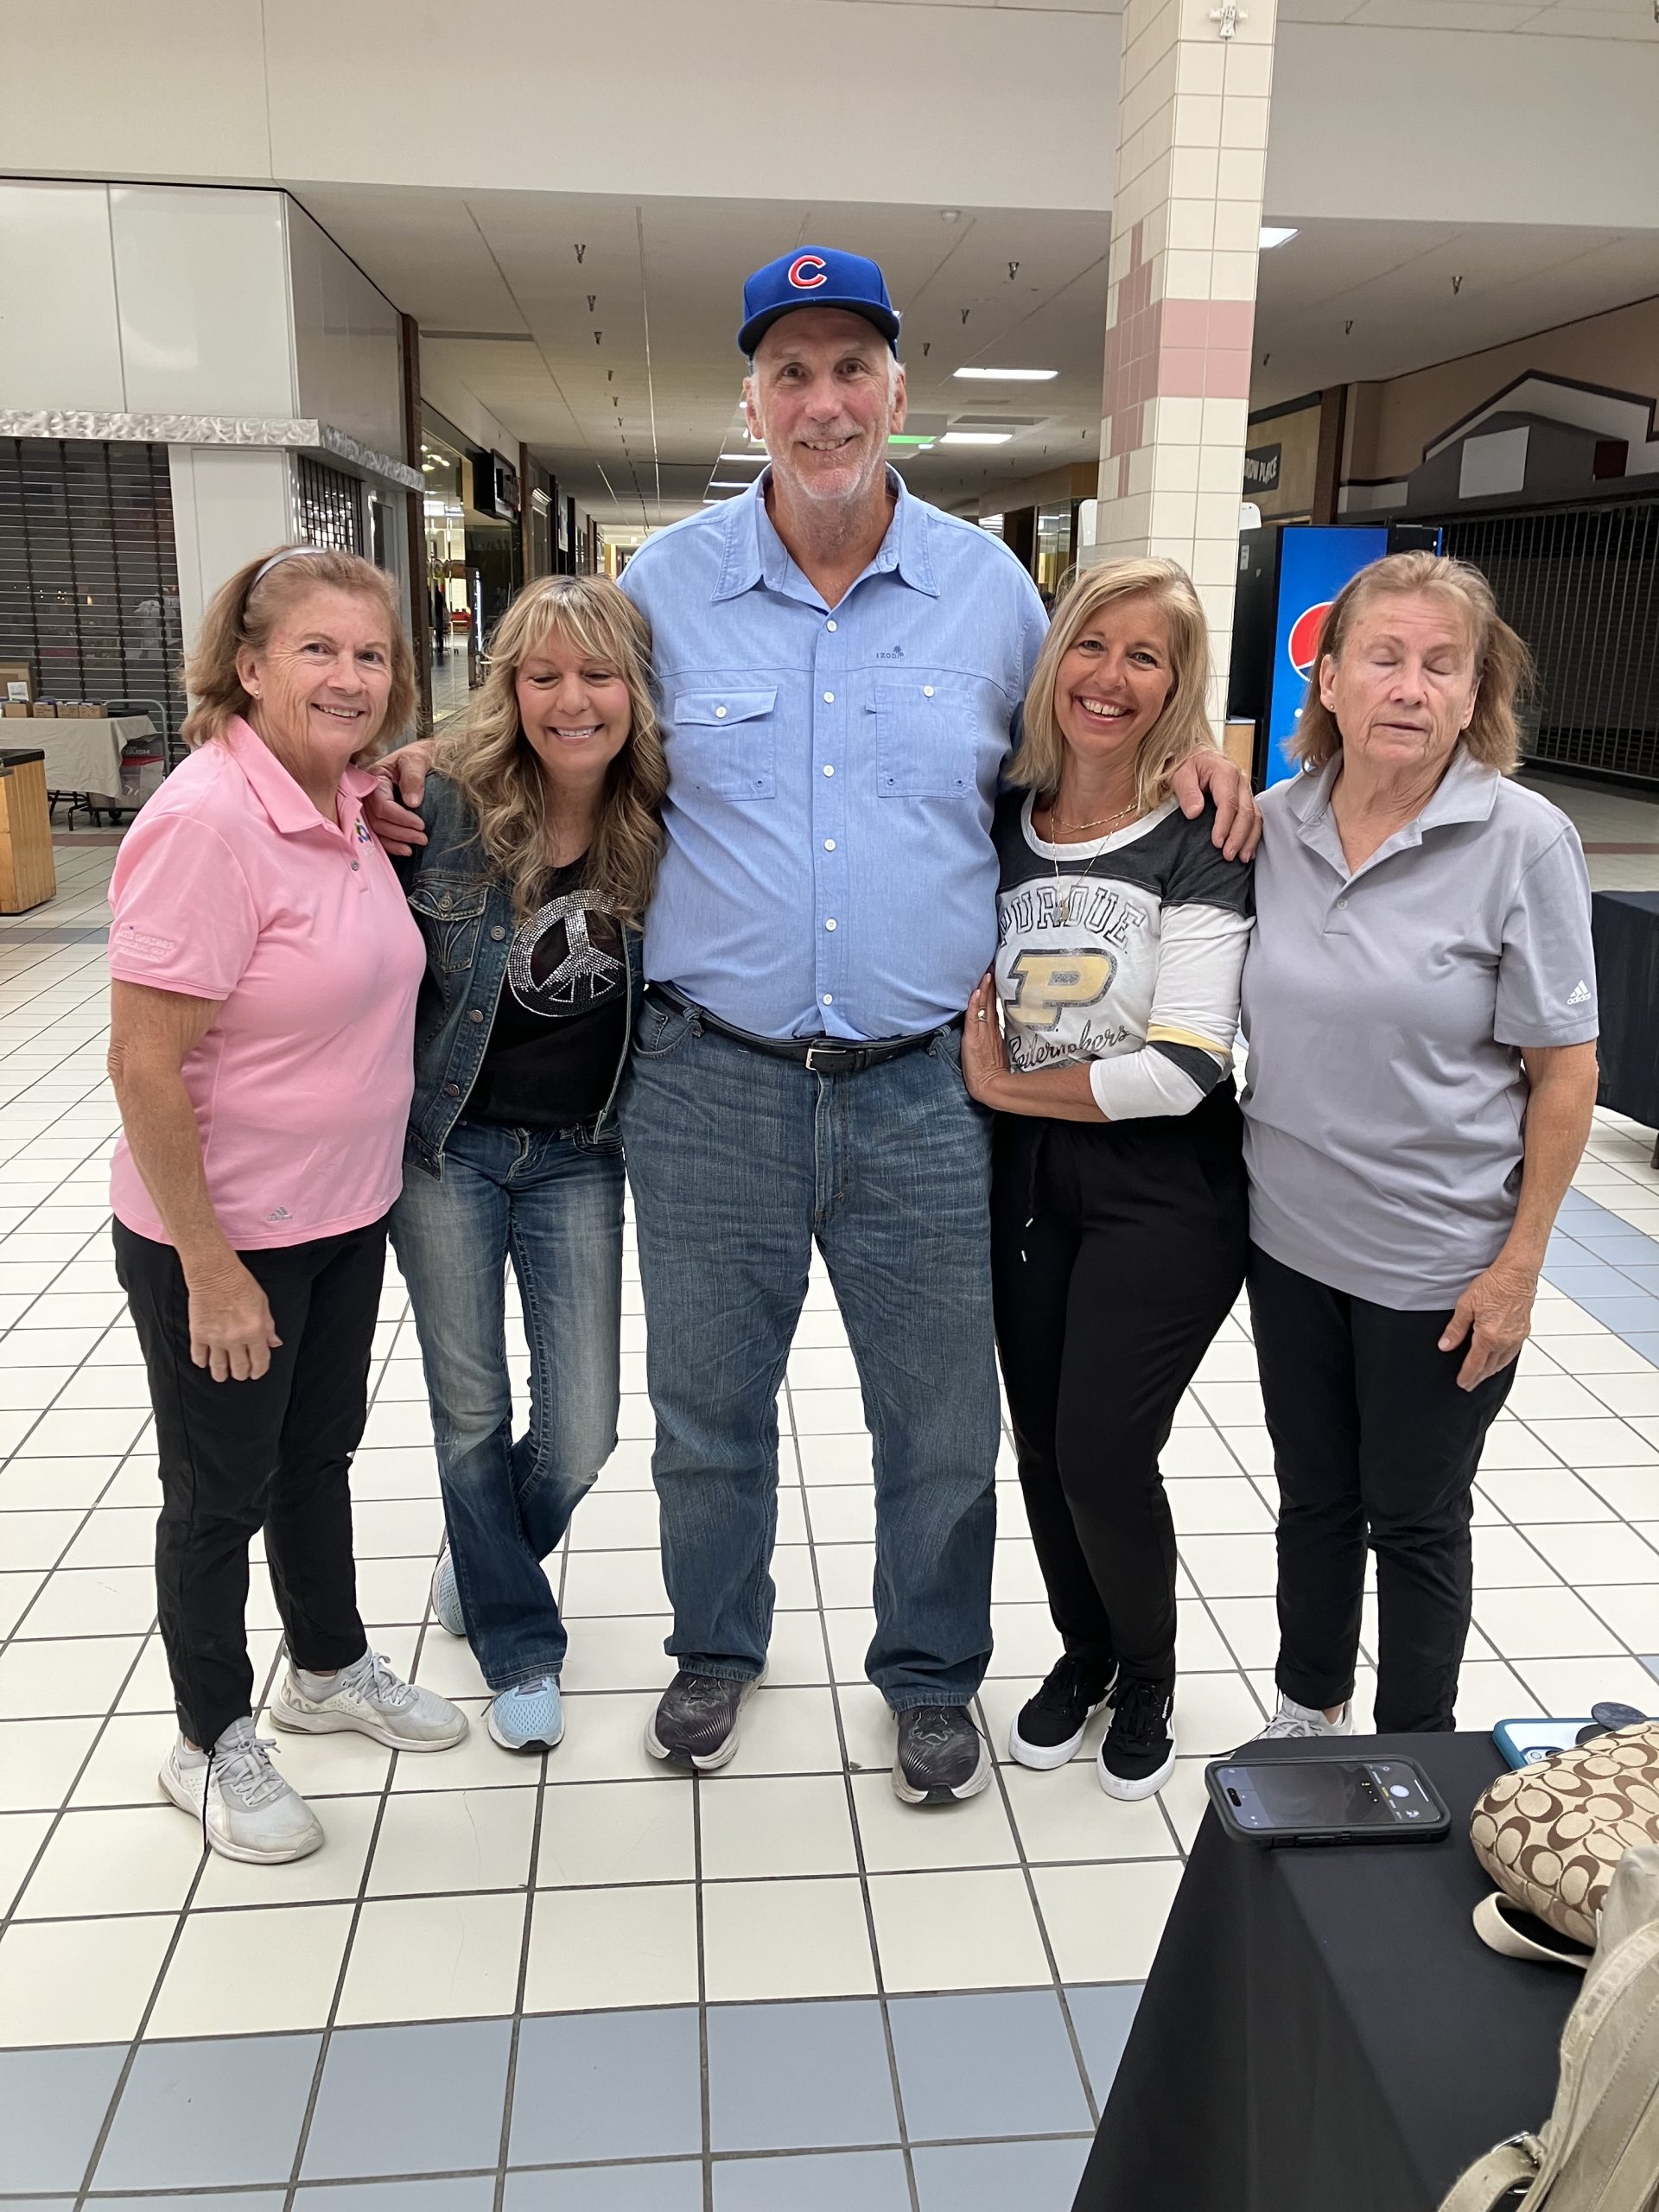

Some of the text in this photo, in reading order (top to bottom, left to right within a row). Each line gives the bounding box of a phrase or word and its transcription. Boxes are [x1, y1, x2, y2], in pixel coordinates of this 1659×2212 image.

[788, 254, 828, 289] C
[998, 885, 1147, 950] PURDUE
[1004, 947, 1118, 1032] P
